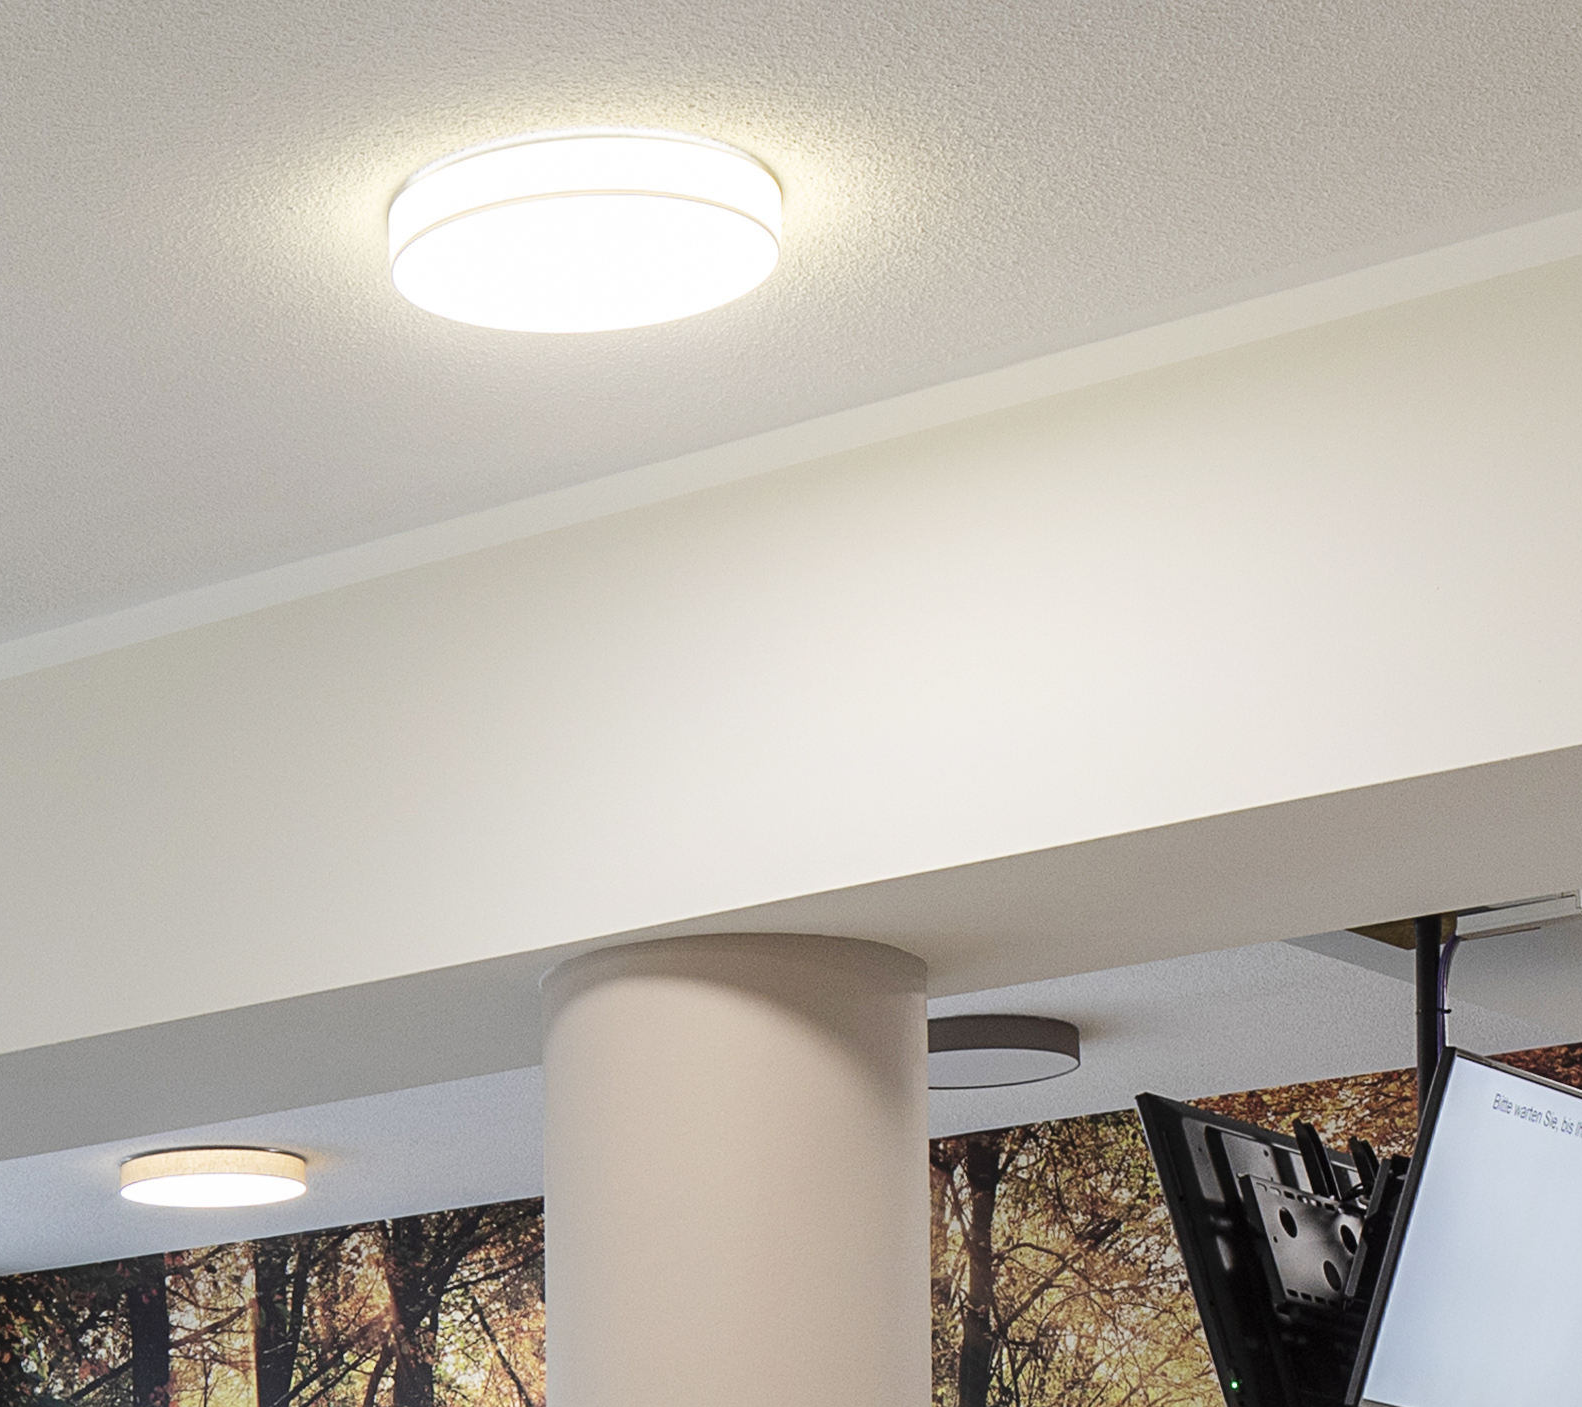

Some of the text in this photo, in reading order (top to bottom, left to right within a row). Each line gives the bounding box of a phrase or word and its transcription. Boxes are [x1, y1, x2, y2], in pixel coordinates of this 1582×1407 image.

[1492, 1093, 1513, 1114] Bitte
[1514, 1103, 1543, 1124] warten
[1543, 1110, 1559, 1133] Sie,
[1561, 1116, 1574, 1135] bis
